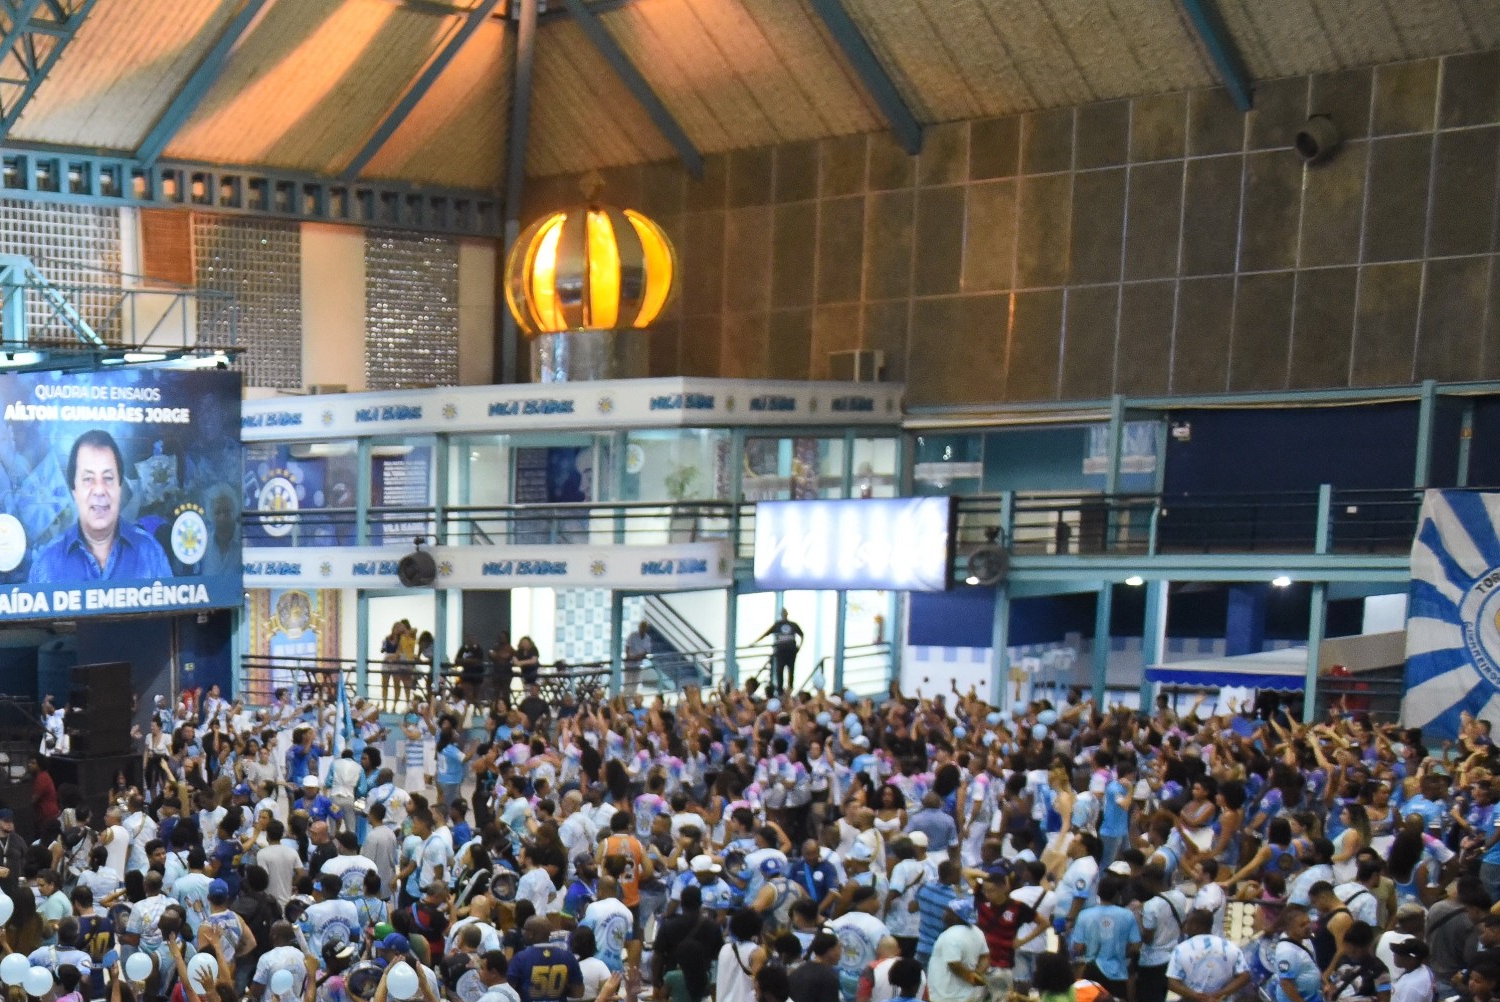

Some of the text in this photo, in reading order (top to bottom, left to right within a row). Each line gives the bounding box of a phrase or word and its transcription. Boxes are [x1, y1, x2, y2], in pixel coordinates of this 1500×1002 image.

[35, 384, 161, 401] QUADRA DE ENSAIOS
[4, 401, 190, 423] AÍLTON GUIMARÃES JORGE
[53, 590, 82, 611] DE
[85, 581, 209, 609] EMERGÊNCIA
[531, 963, 568, 998] 50
